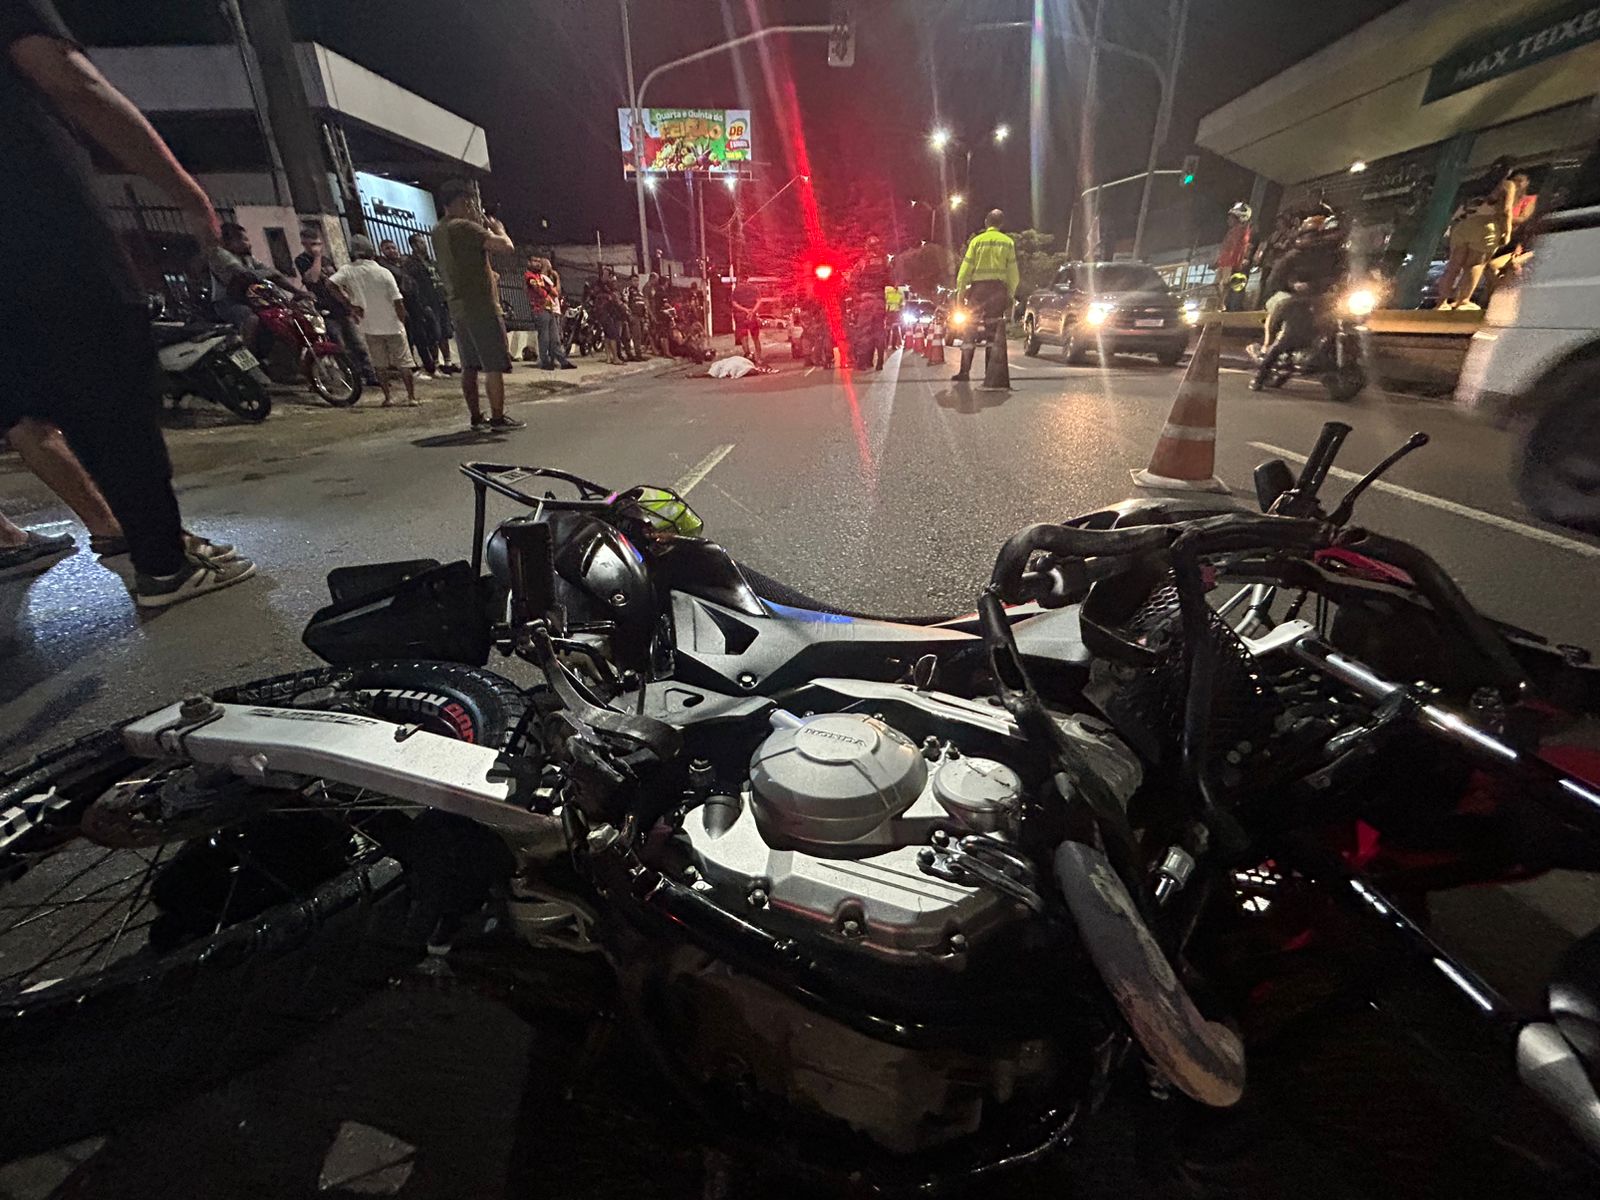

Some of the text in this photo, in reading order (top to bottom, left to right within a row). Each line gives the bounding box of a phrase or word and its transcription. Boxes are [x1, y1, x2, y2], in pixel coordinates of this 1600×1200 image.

[1454, 8, 1600, 83] MAX TEIXE
[655, 110, 681, 121] Quarta
[688, 109, 713, 120] Quinta
[729, 126, 743, 136] DB
